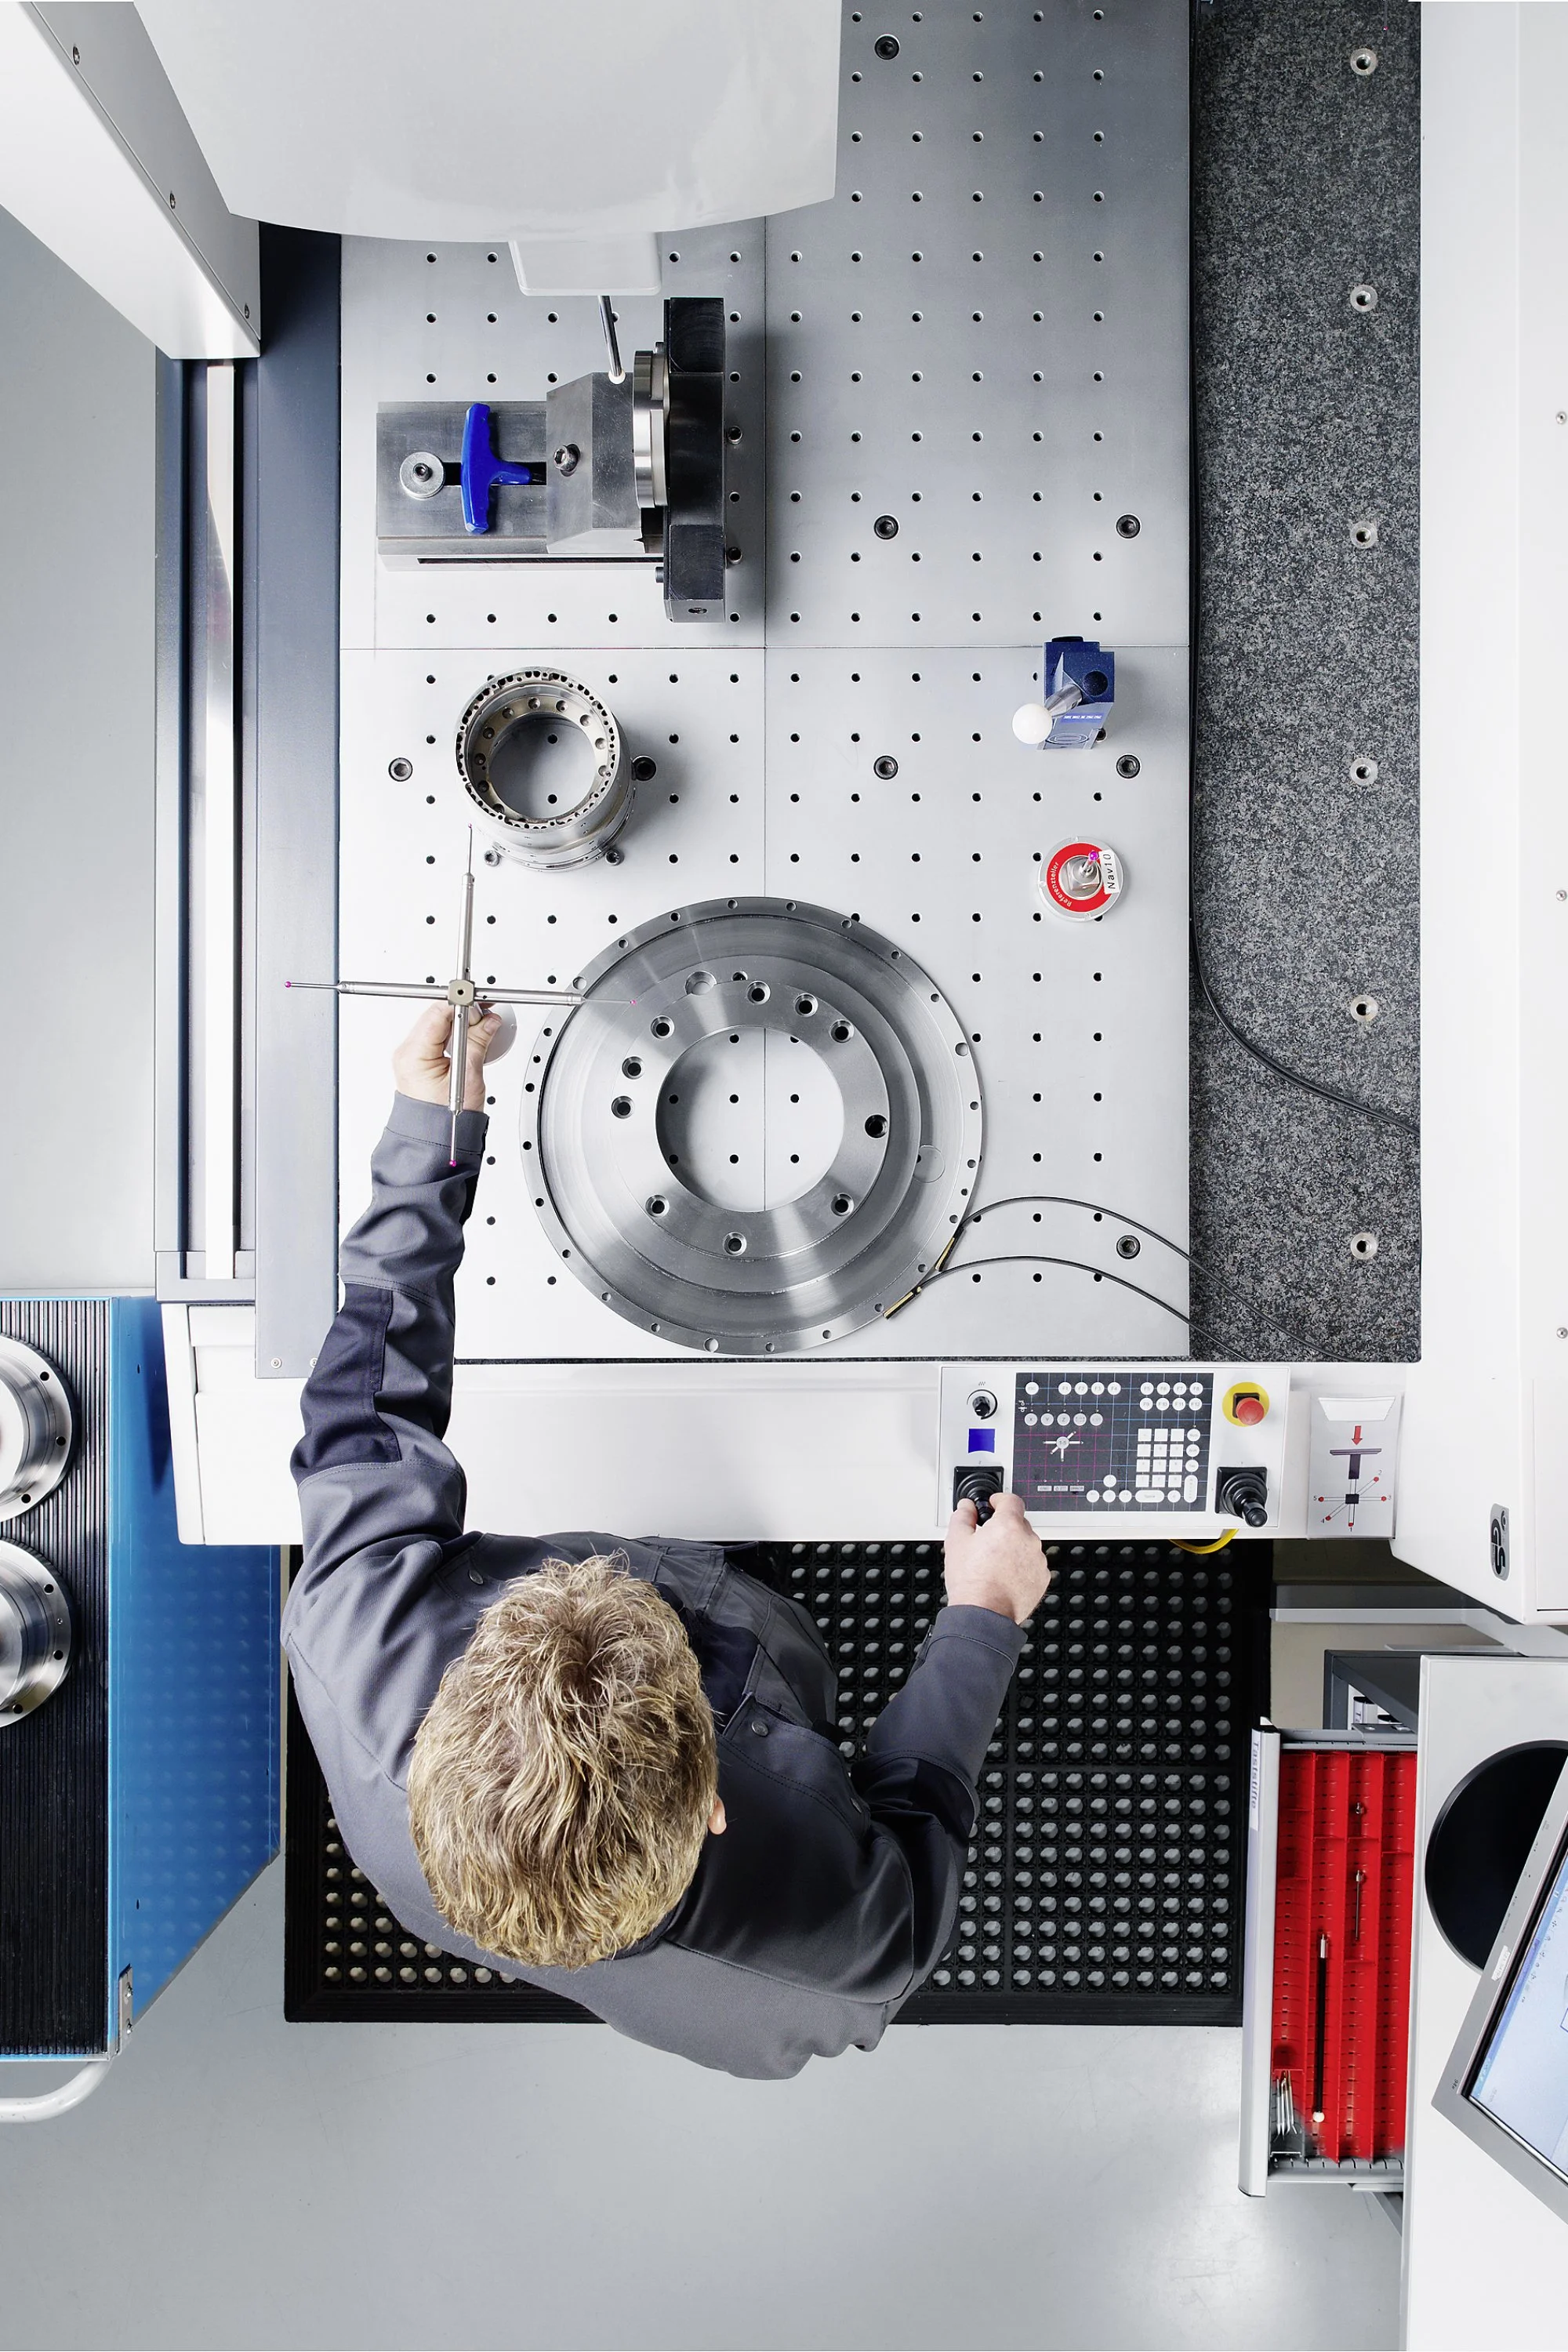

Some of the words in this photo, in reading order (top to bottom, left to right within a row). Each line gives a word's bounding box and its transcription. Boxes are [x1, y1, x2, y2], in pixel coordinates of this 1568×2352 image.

[1050, 862, 1073, 907] Referenzteller
[1102, 854, 1116, 890] Nav10
[1250, 1741, 1259, 1809] Taststifte
